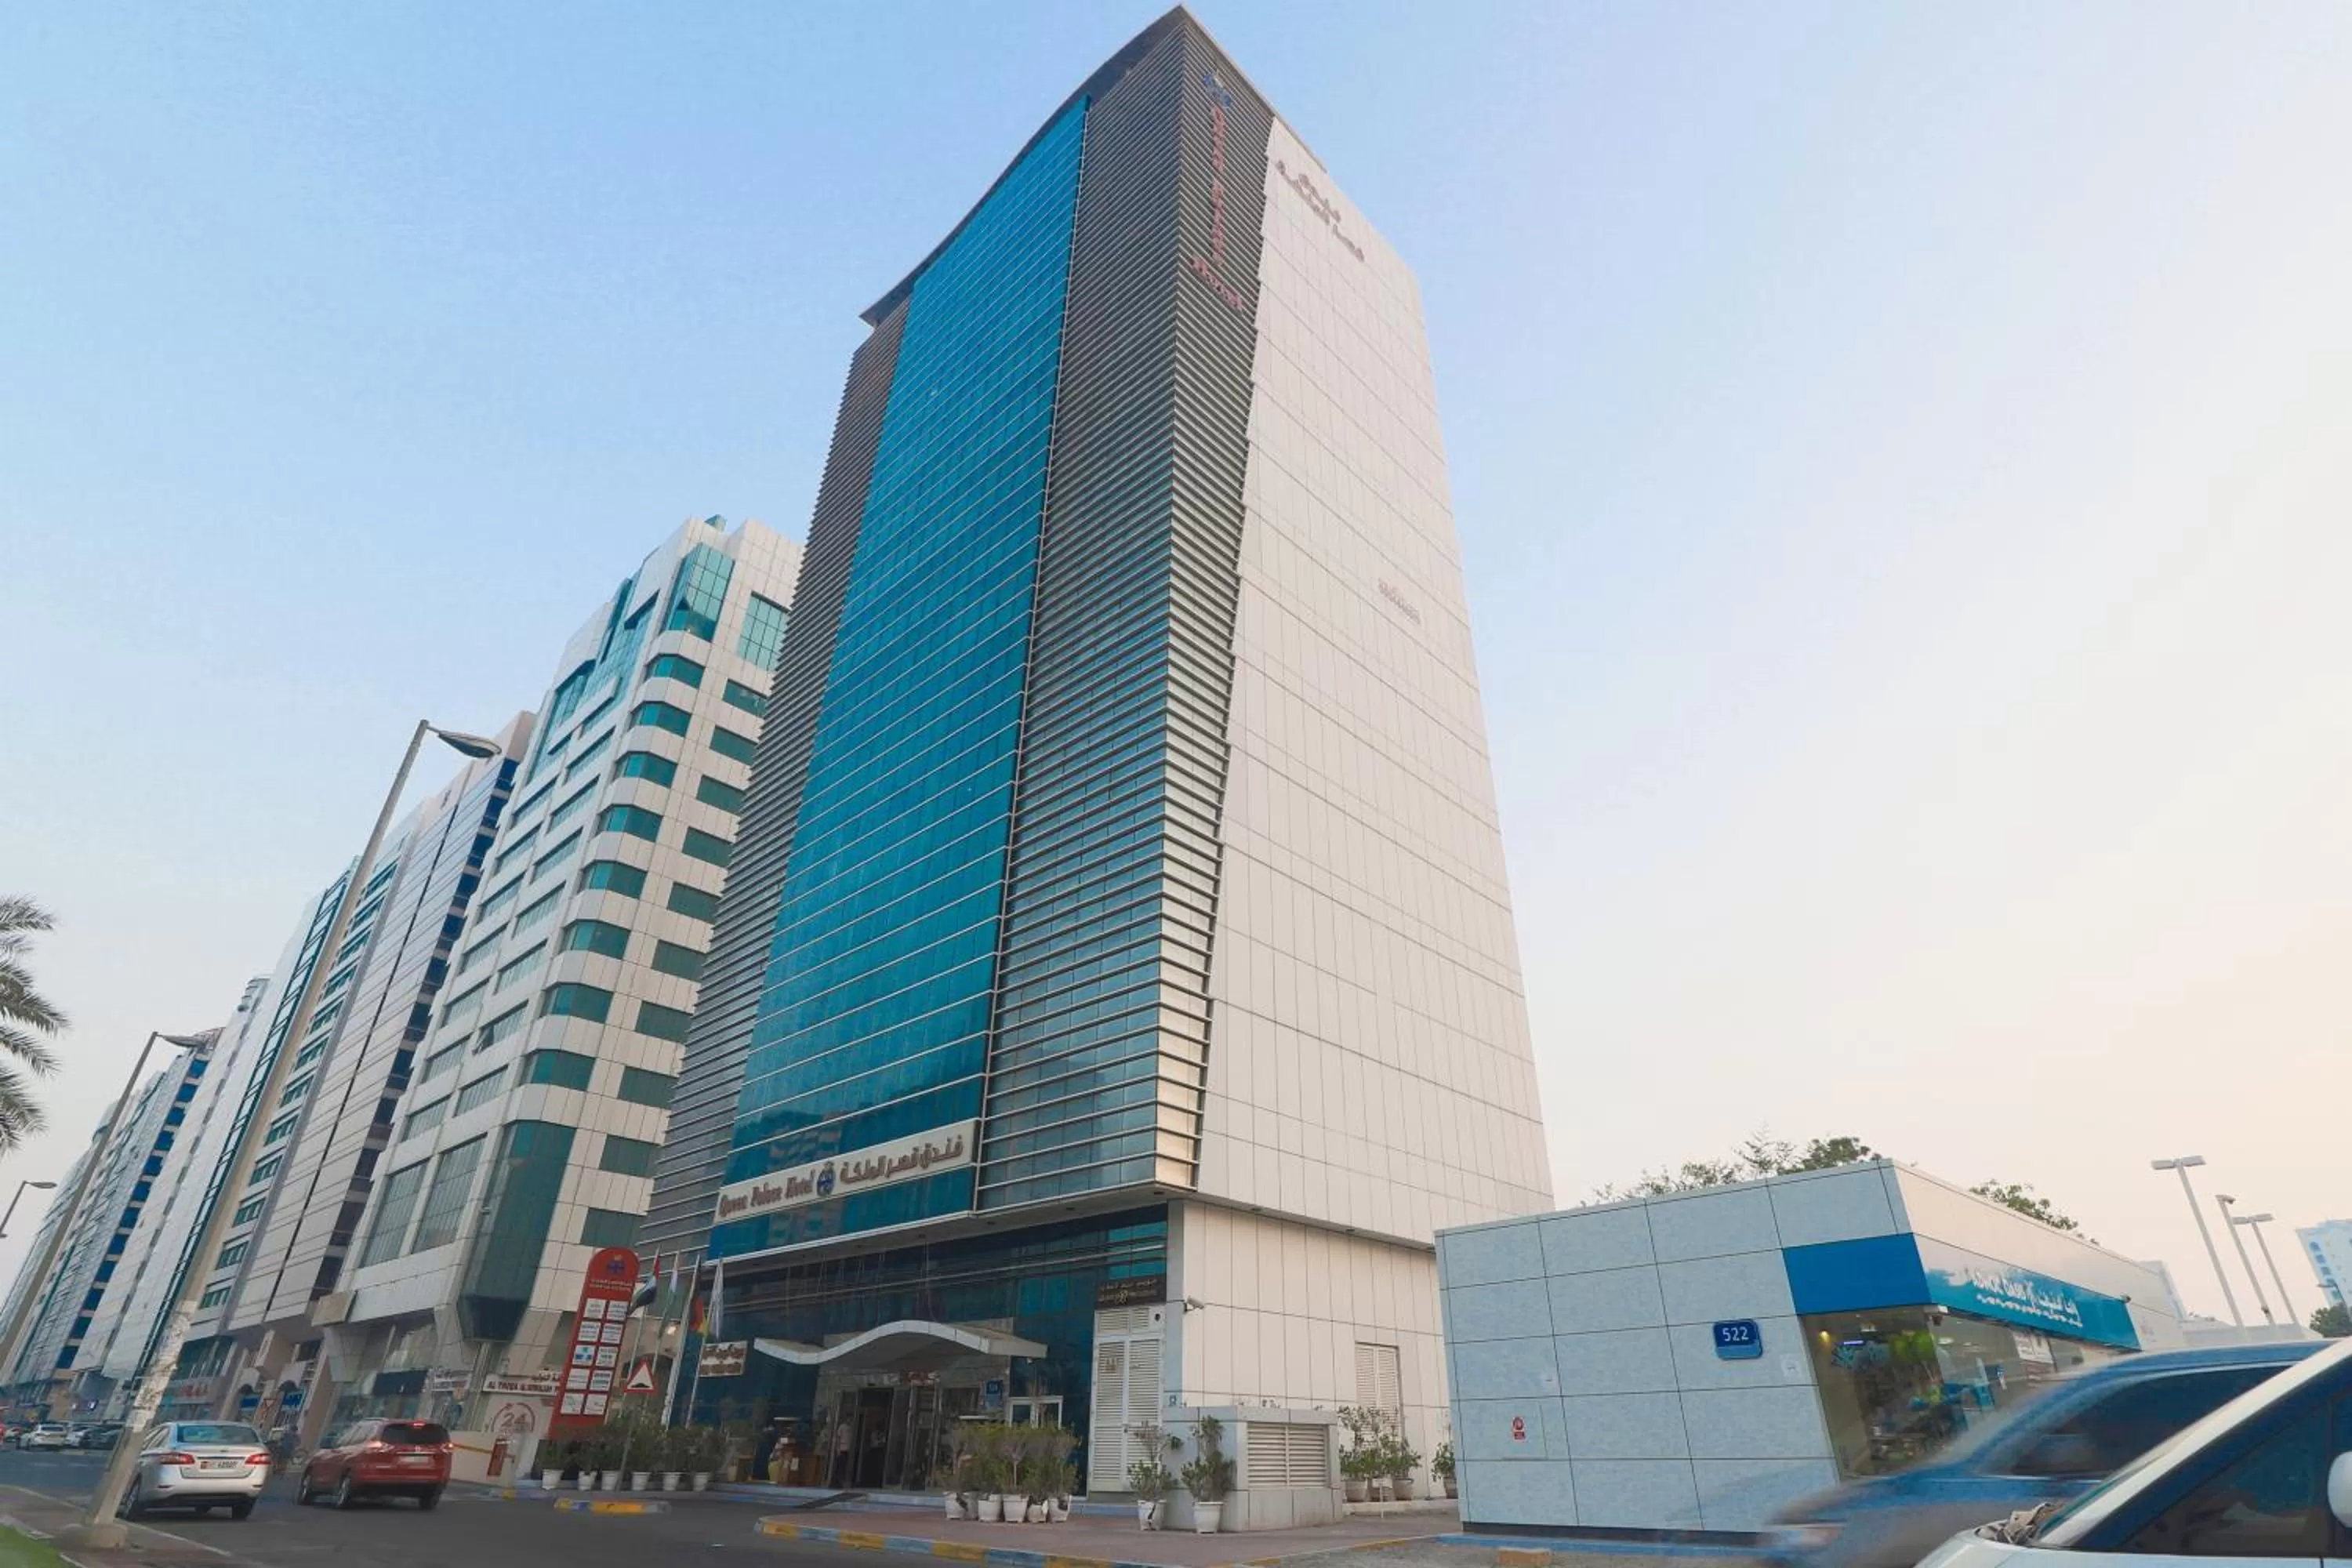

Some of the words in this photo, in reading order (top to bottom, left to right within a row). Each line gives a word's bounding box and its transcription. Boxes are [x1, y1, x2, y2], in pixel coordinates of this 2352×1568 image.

[919, 1134, 964, 1170] فندق
[1722, 1327, 1749, 1341] 522
[502, 1412, 529, 1432] 24
